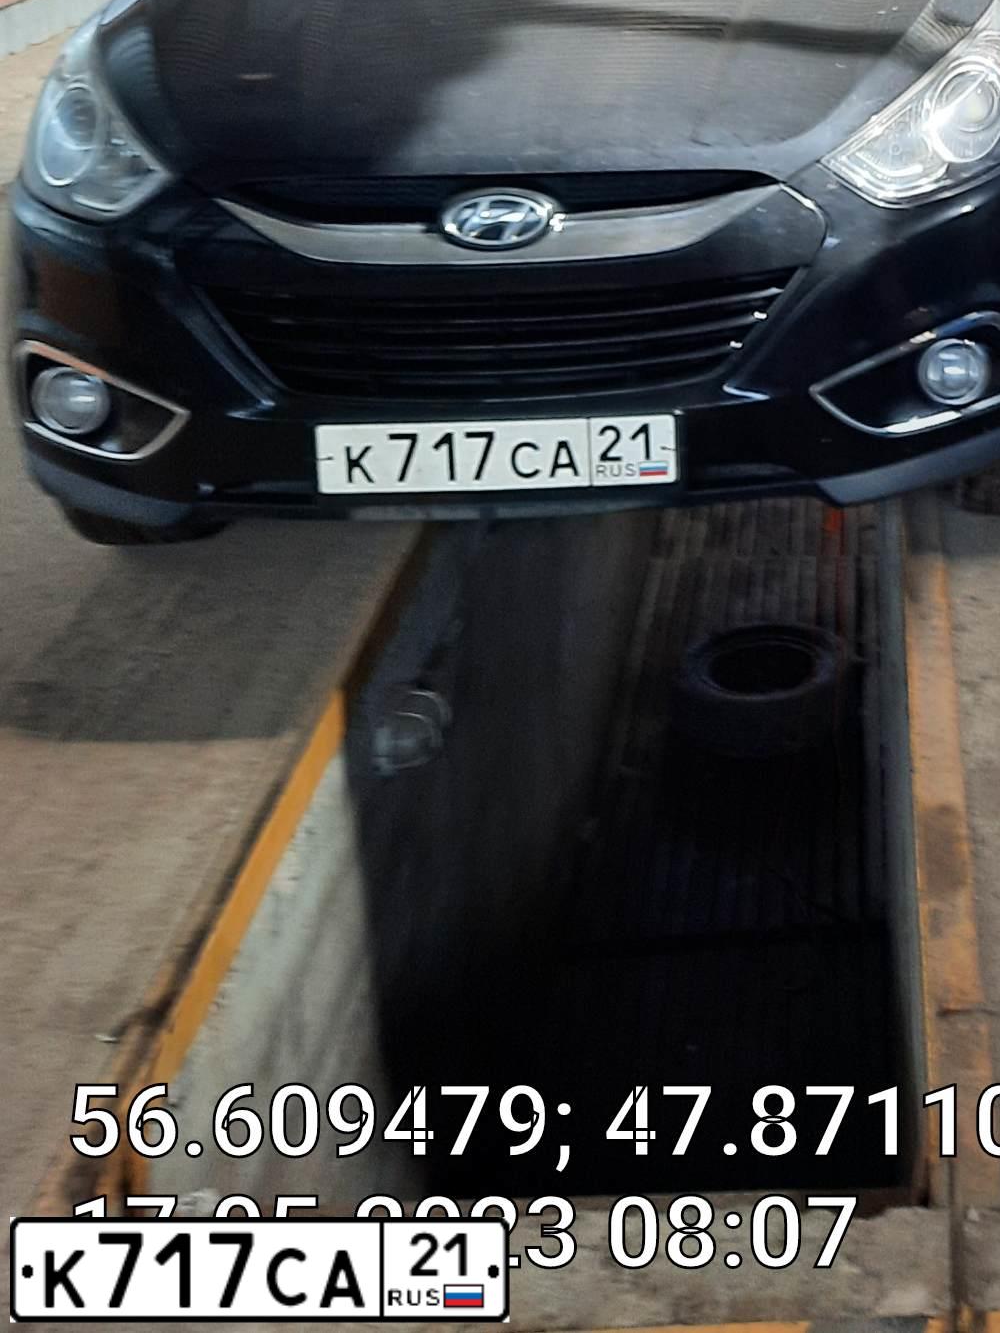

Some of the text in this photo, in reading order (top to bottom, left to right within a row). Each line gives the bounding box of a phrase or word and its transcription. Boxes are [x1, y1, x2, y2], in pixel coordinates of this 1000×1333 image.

[344, 422, 652, 484] К717СА 21
[596, 463, 637, 478] RUS
